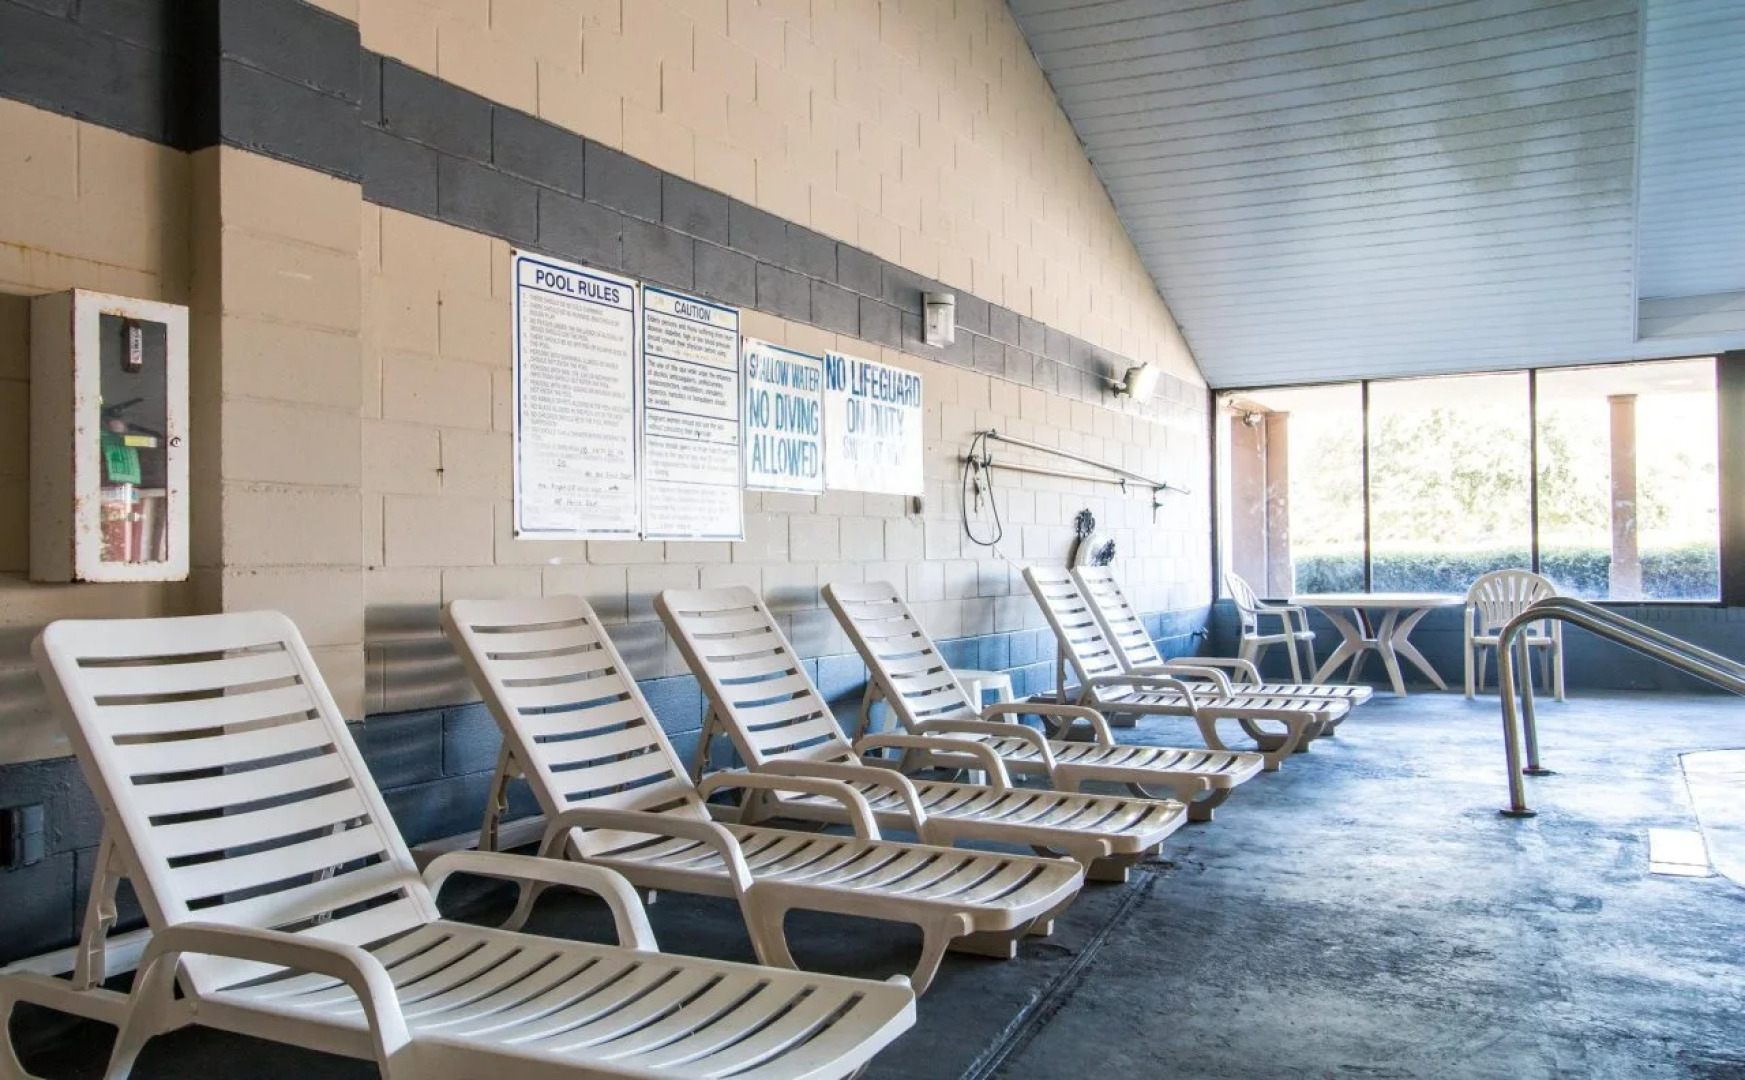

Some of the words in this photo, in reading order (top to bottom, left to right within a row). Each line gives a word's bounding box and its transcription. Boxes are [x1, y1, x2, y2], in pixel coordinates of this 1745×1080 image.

[536, 269, 574, 293] POOL
[578, 280, 620, 304] RULES
[674, 300, 711, 321] CAUTION
[792, 363, 820, 393] WATER
[825, 353, 846, 392] NO
[851, 359, 921, 409] LIFEGUARD
[749, 387, 770, 429] NO
[775, 392, 819, 436] DIVING
[846, 397, 866, 435] ON
[870, 404, 905, 437] DUTY
[751, 433, 819, 479] ALLOWED
